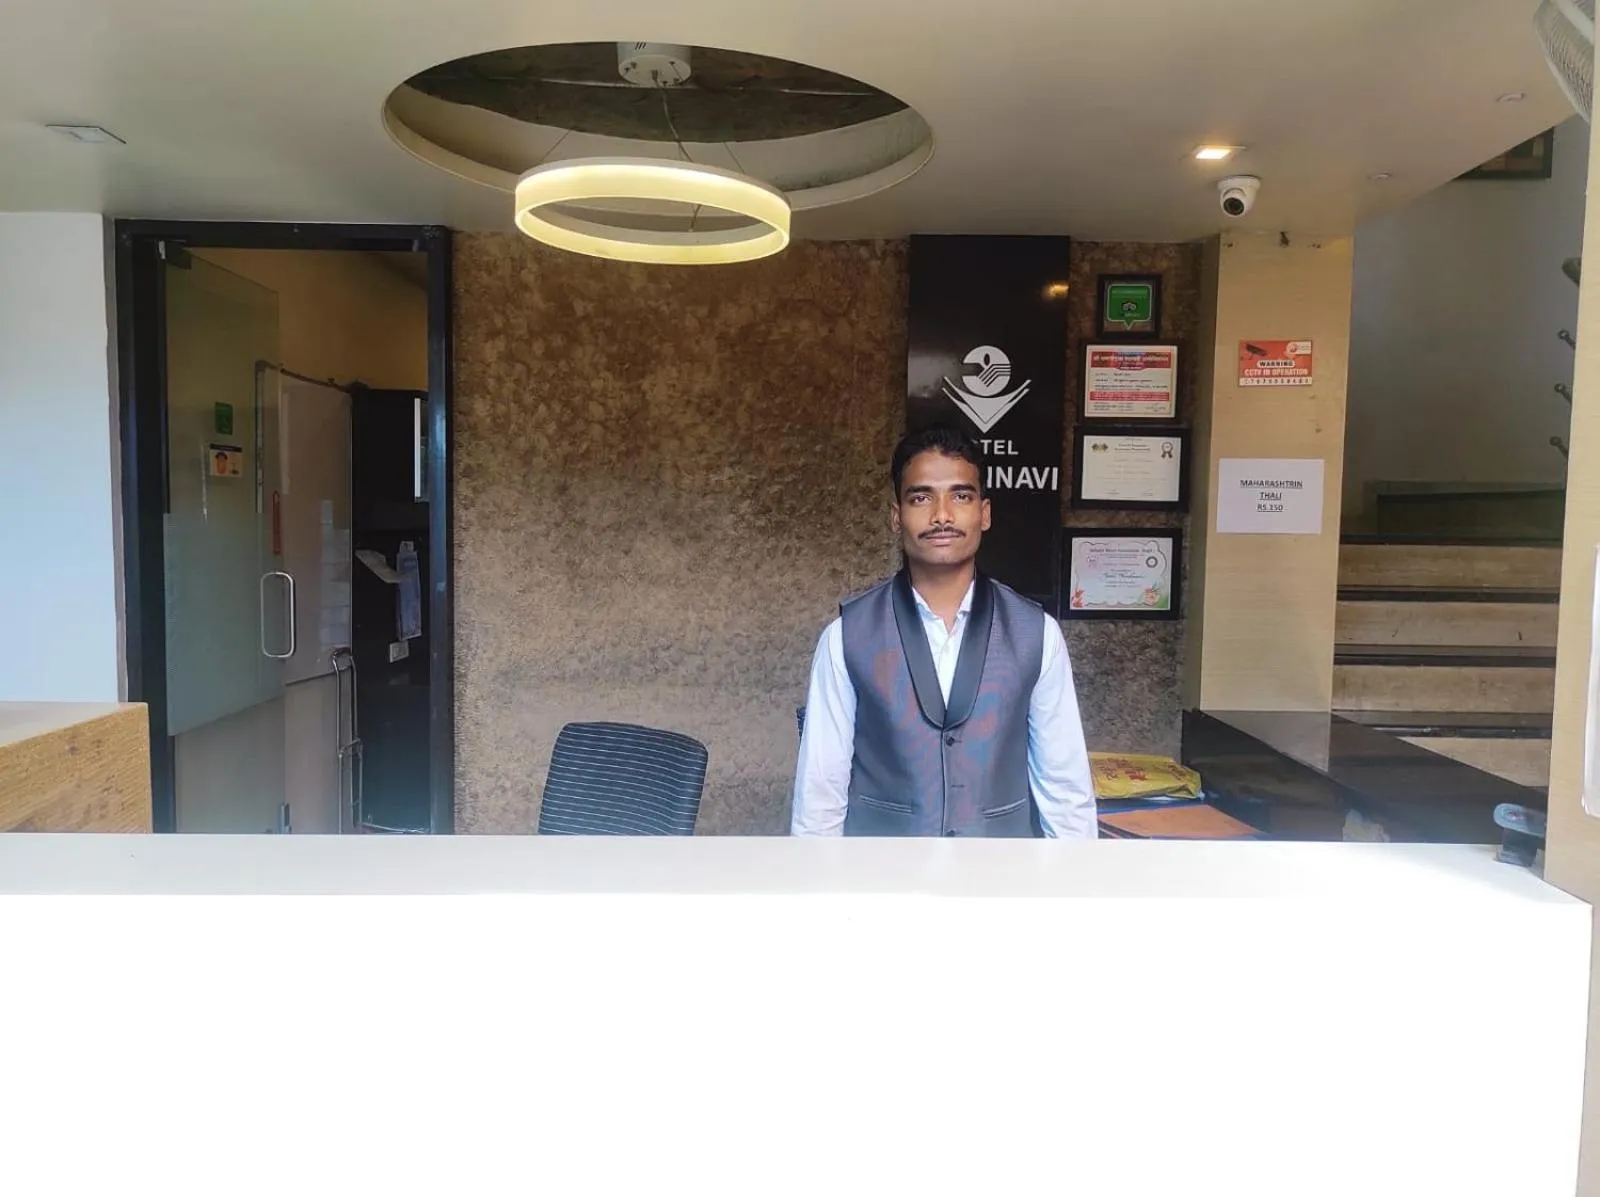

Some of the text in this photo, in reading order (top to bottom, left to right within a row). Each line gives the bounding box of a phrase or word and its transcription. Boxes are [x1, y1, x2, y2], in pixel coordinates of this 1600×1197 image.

[971, 439, 1019, 455] TEL
[986, 466, 1058, 490] INAVI
[1240, 479, 1303, 489] MAHARASHTRIN
[1259, 492, 1282, 501] THALI
